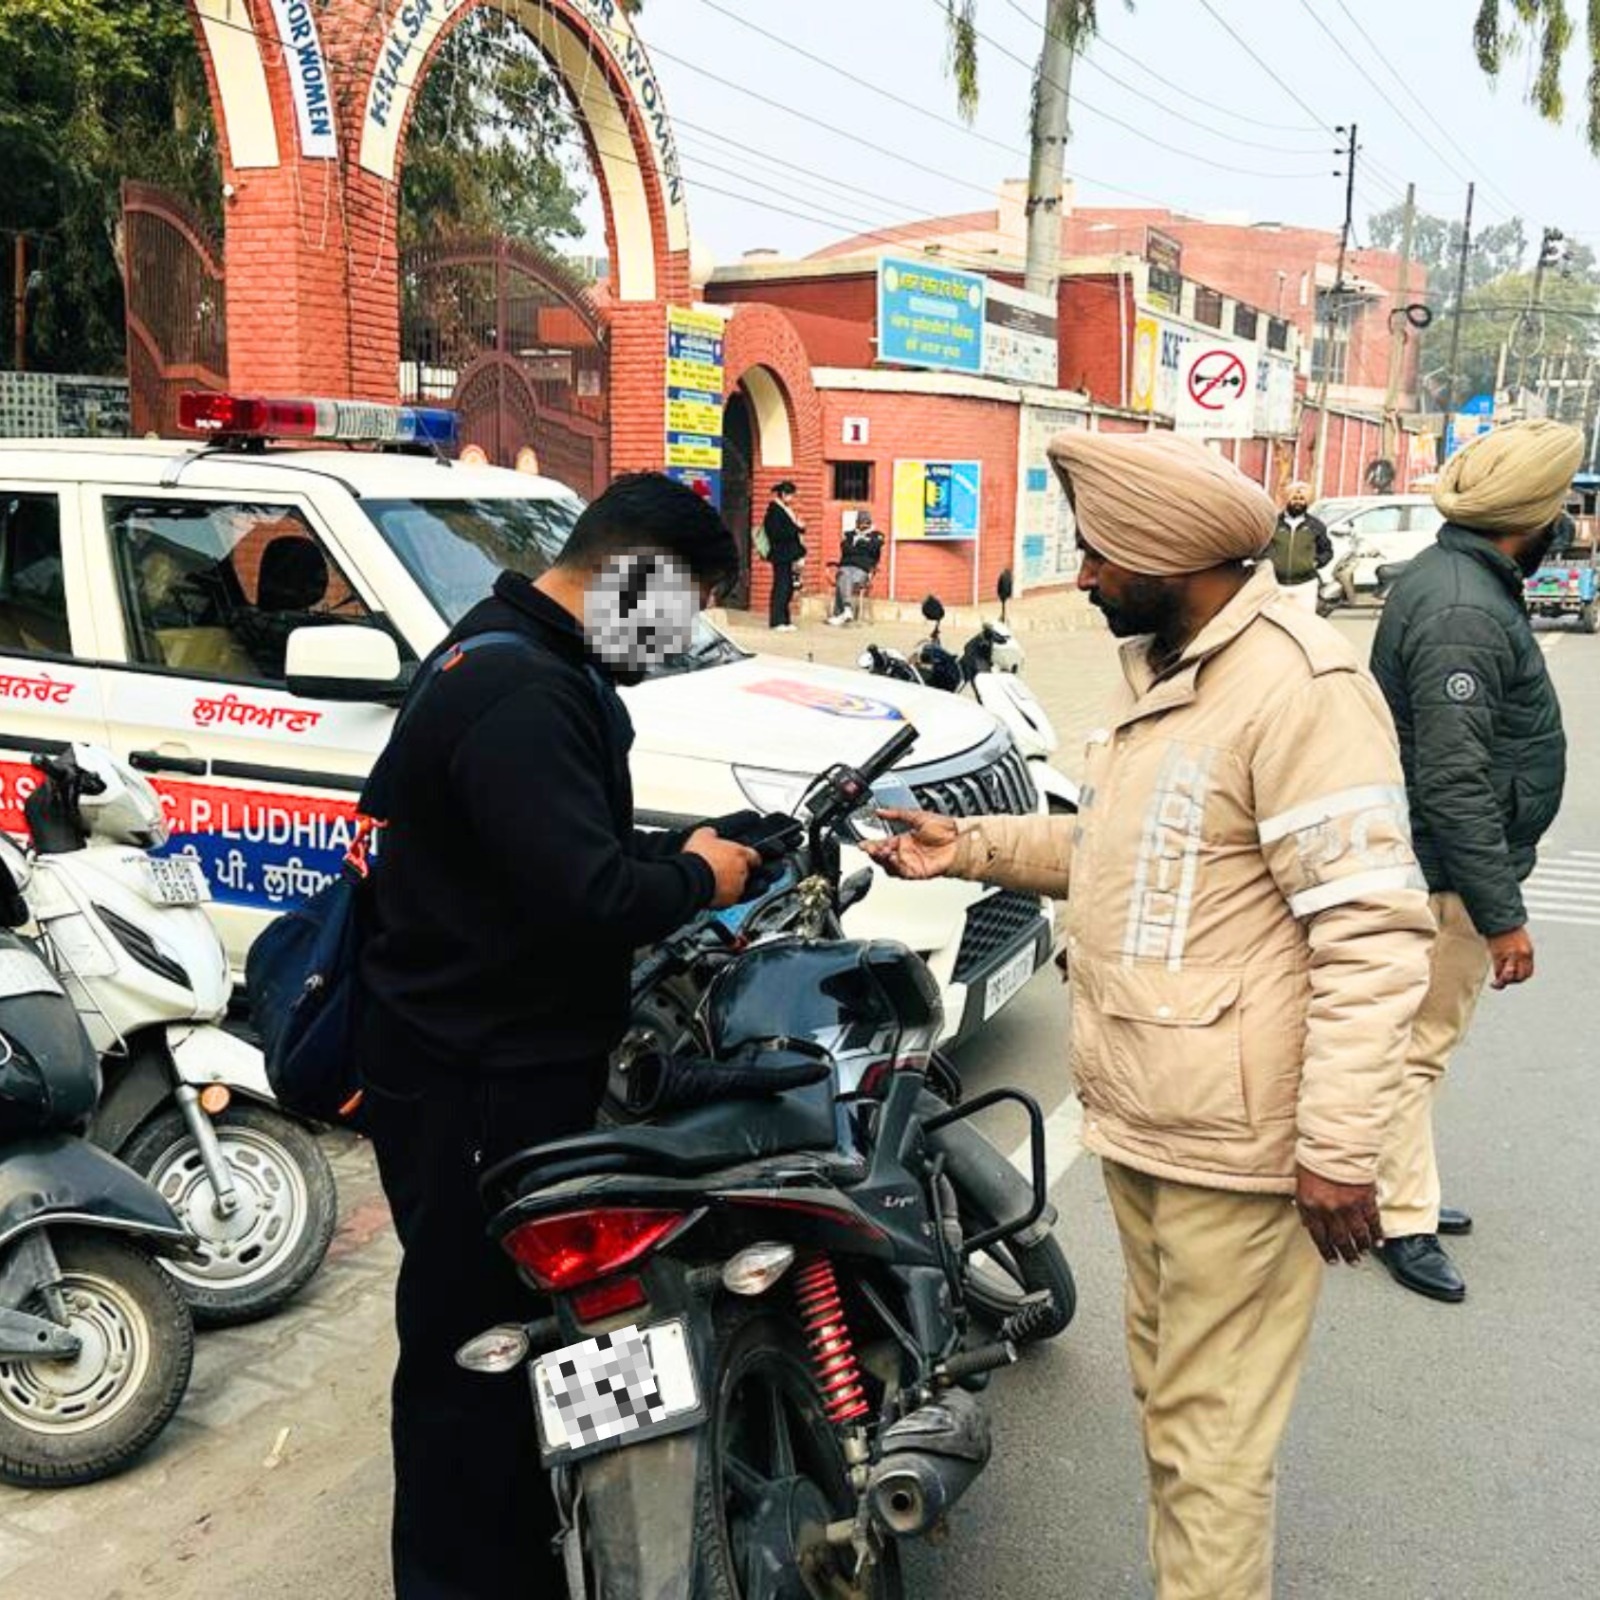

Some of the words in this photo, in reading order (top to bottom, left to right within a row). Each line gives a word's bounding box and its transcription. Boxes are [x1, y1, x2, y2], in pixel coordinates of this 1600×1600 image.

[297, 40, 332, 136] WOMEN
[625, 35, 683, 208] WOMEN
[850, 423, 861, 442] 1
[192, 692, 323, 733] ਲੁਧਿਆਣਾ
